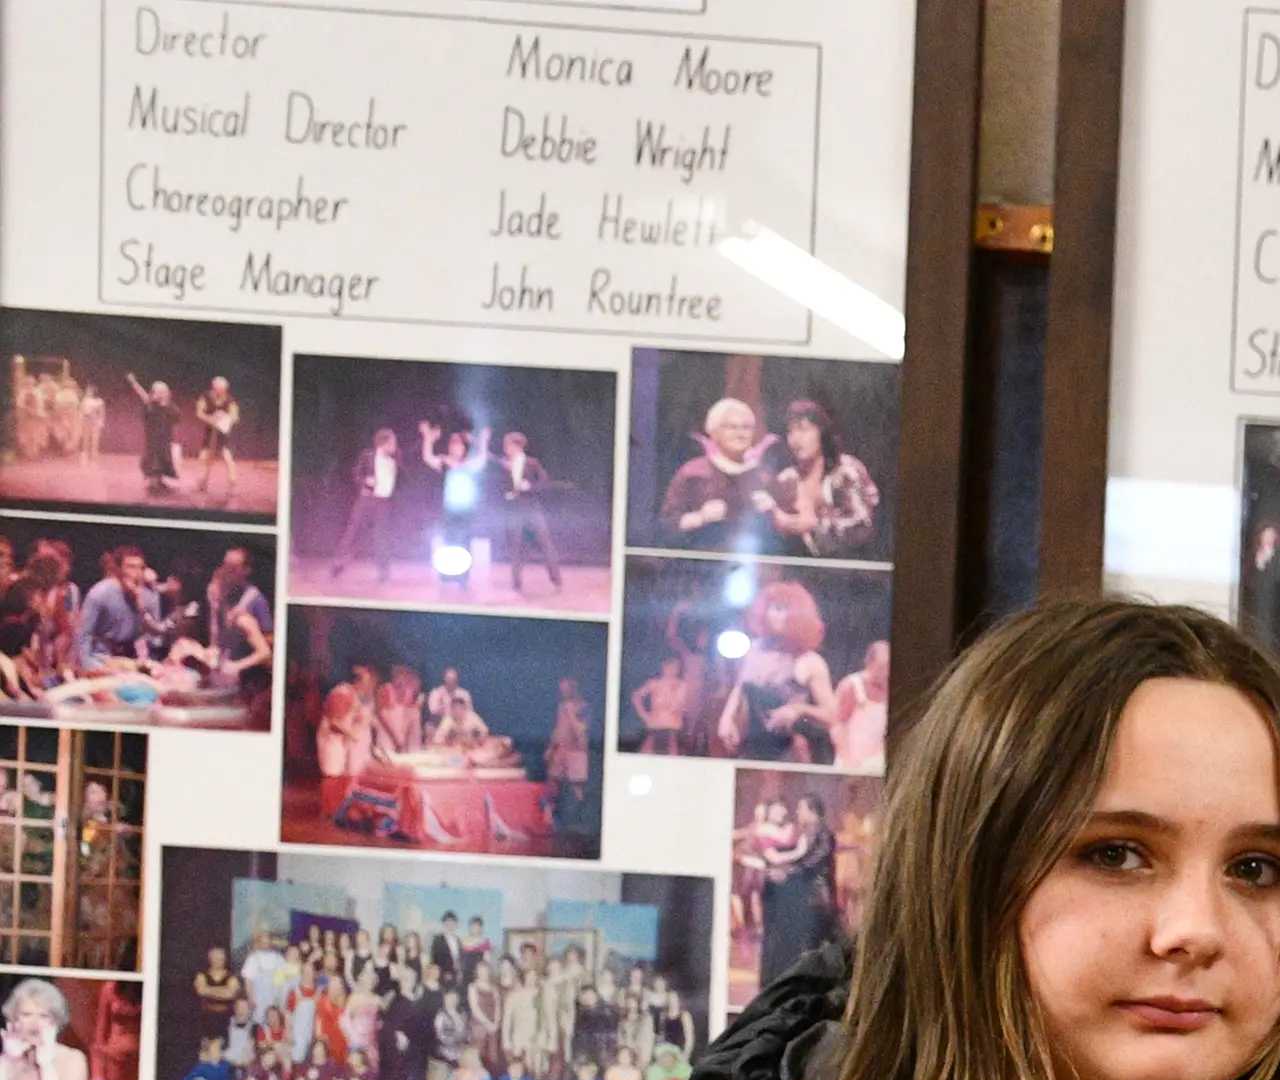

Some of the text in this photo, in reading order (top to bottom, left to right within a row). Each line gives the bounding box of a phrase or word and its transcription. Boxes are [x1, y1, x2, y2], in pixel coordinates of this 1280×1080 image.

[135, 6, 267, 59] Director
[506, 33, 774, 97] Monica Moore
[128, 84, 407, 150] Musical Director
[499, 104, 732, 185] Debbie Wright
[126, 161, 348, 233] Choreographer
[489, 189, 562, 241] Jade
[117, 237, 380, 316] Stage Manager
[481, 262, 723, 322] John Rountree
